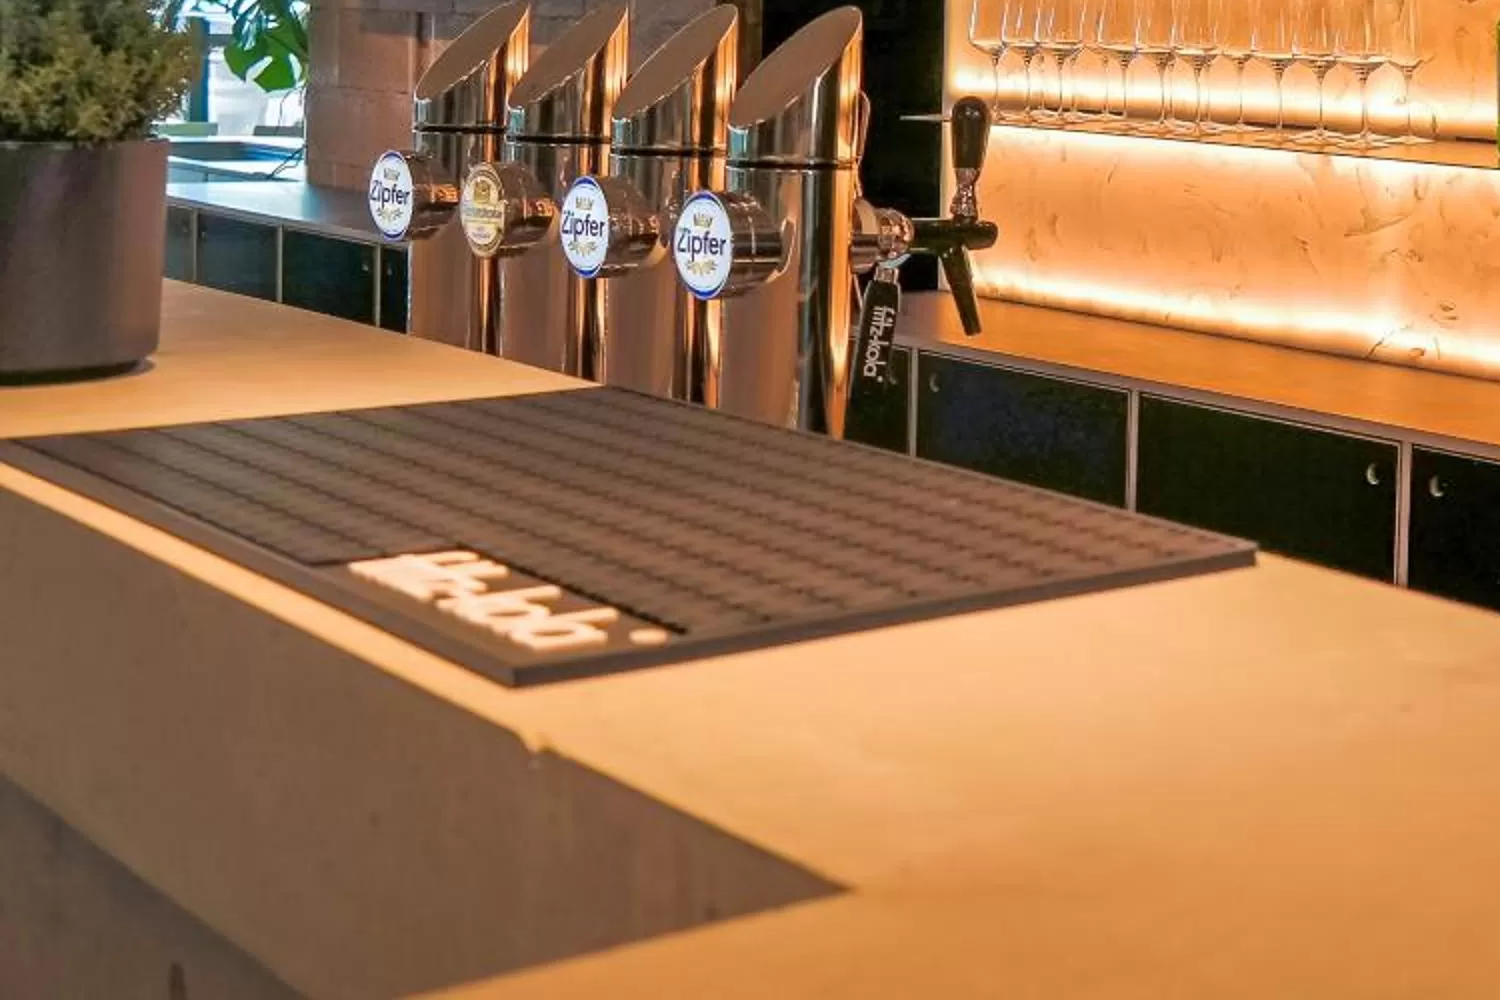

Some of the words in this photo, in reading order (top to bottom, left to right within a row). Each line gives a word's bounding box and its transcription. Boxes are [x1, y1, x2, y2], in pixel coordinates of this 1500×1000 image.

[370, 180, 411, 210] Zipfer
[561, 209, 605, 242] Zipfer
[677, 227, 727, 262] Zipfer
